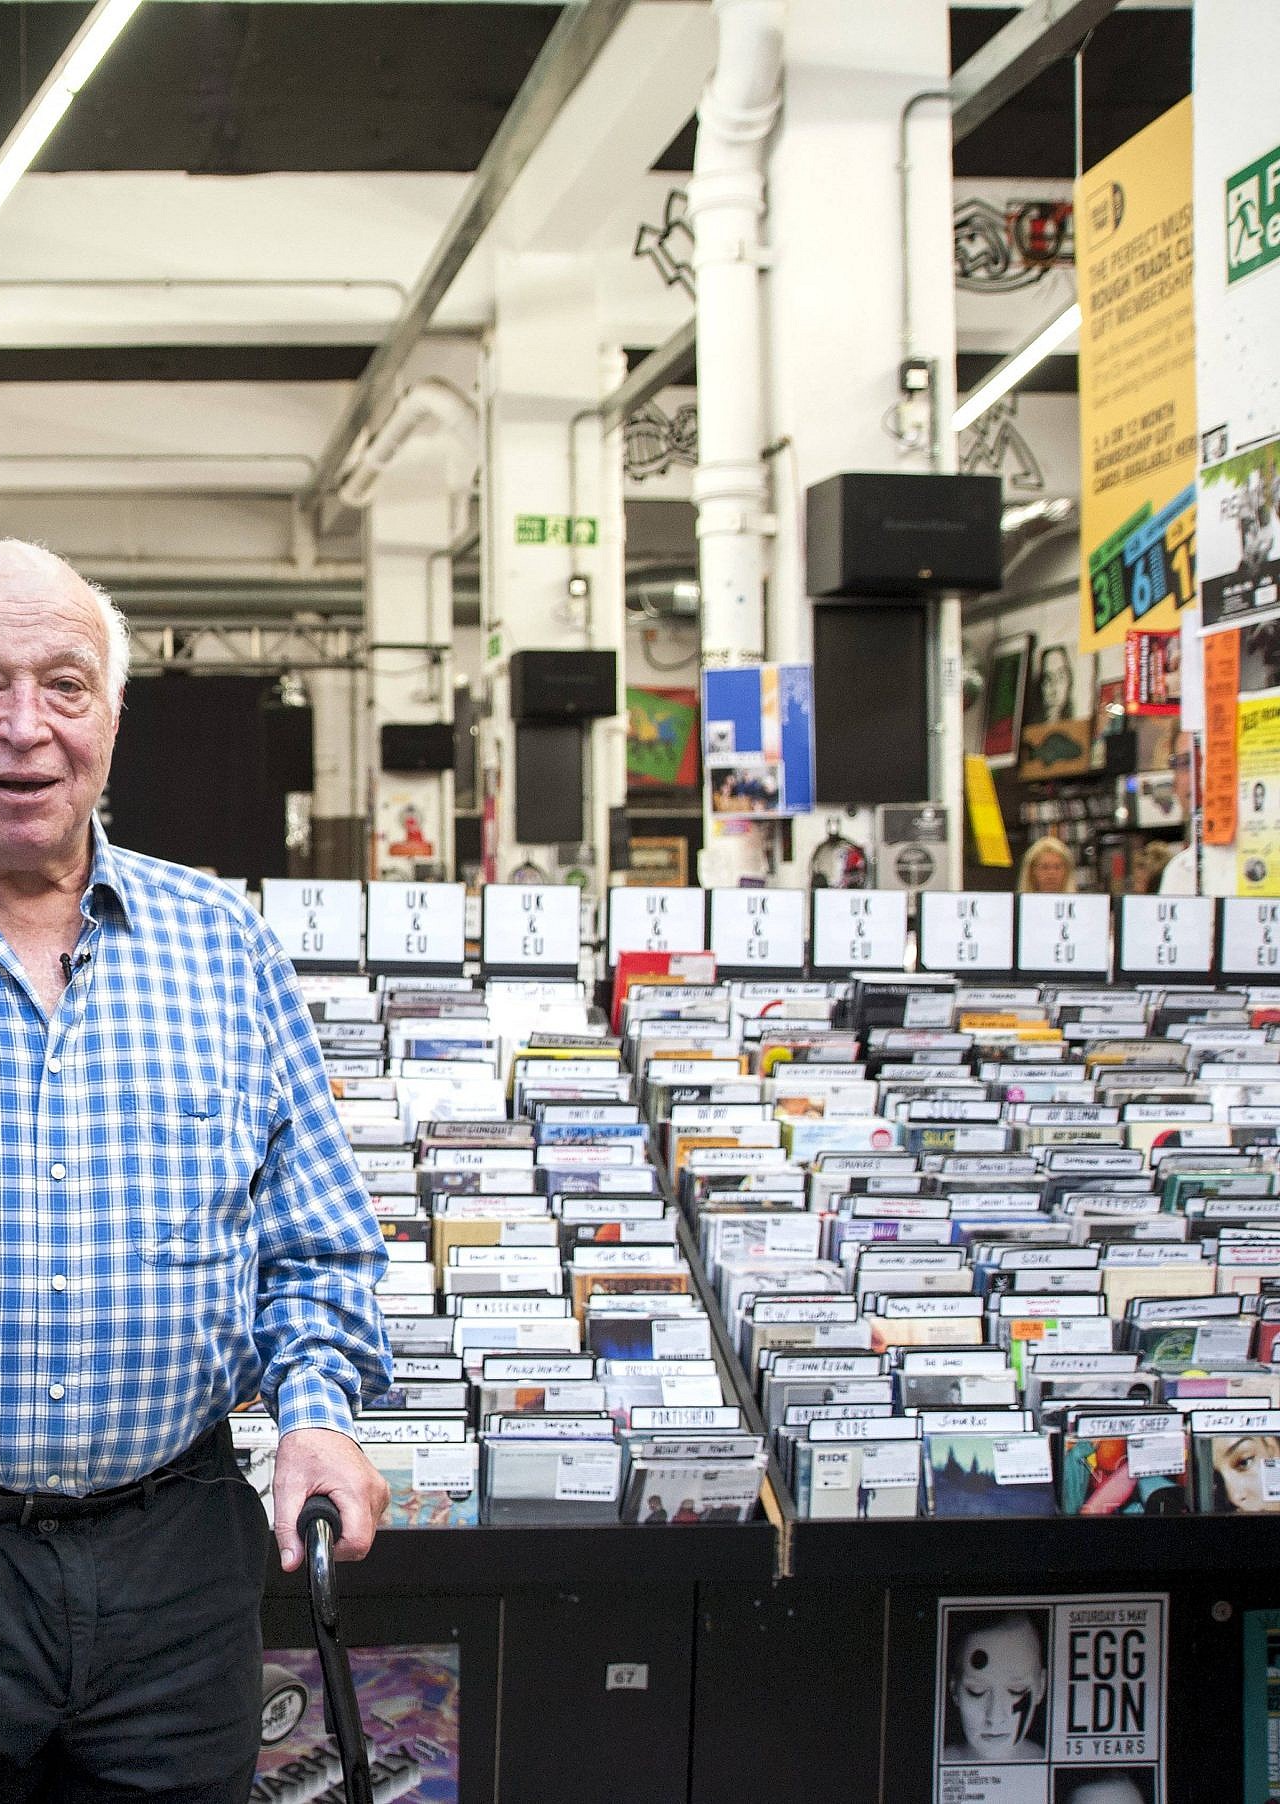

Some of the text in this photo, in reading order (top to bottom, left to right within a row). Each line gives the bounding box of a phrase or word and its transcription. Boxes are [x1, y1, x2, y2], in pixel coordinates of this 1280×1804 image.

[302, 889, 324, 907] UK
[406, 891, 428, 909] UK
[522, 894, 544, 912] UK
[646, 896, 668, 914] UK
[747, 896, 768, 915] UK
[850, 896, 871, 915] UK
[957, 900, 978, 919] UK
[1055, 901, 1076, 920] UK
[1157, 903, 1178, 921] UK
[1258, 905, 1279, 922] UK
[302, 934, 324, 952] EU
[406, 935, 428, 953] EU
[523, 938, 544, 956] EU
[747, 940, 768, 959] EU
[850, 940, 871, 959] EU
[957, 943, 978, 962] EU
[1055, 944, 1076, 962] EU
[1157, 945, 1177, 963] EU
[1257, 945, 1278, 965] EU
[835, 1422, 868, 1436] RIDE
[1239, 1415, 1268, 1428] SMITH
[818, 1453, 848, 1463] RIDE
[1070, 1608, 1148, 1623] SATURDAY 5 MAY
[1070, 1629, 1147, 1681] EGG
[613, 1671, 635, 1685] 67
[1069, 1681, 1146, 1734] LDN
[1066, 1738, 1146, 1756] 15 YEARS
